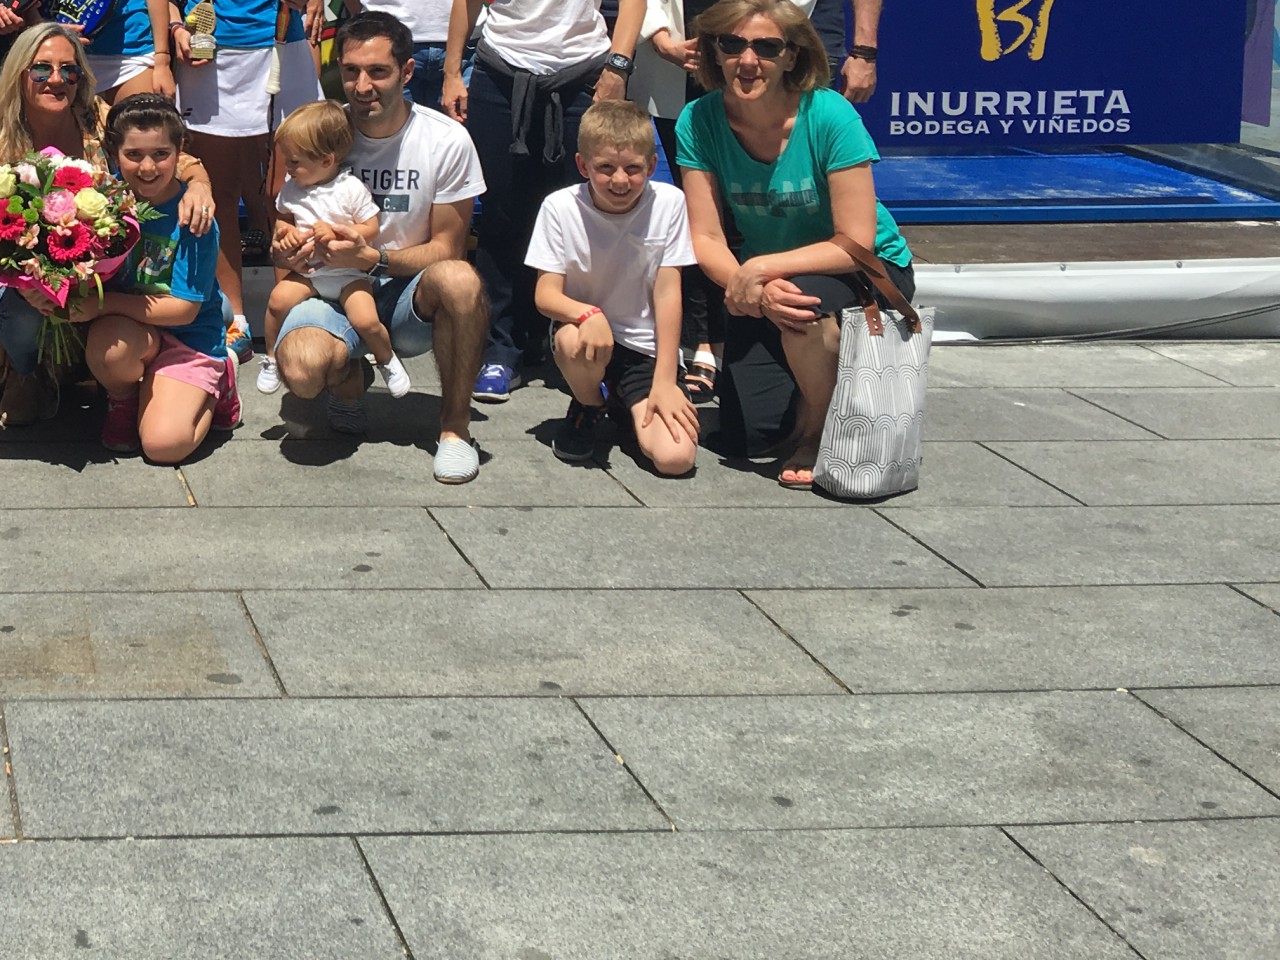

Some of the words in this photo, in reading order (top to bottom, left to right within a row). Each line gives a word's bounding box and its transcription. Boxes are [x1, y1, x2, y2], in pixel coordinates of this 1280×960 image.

[890, 89, 1132, 117] INURRIETA
[889, 120, 991, 136] BODEGA
[999, 120, 1014, 135] Y
[1022, 115, 1132, 135] VIÑEDOS
